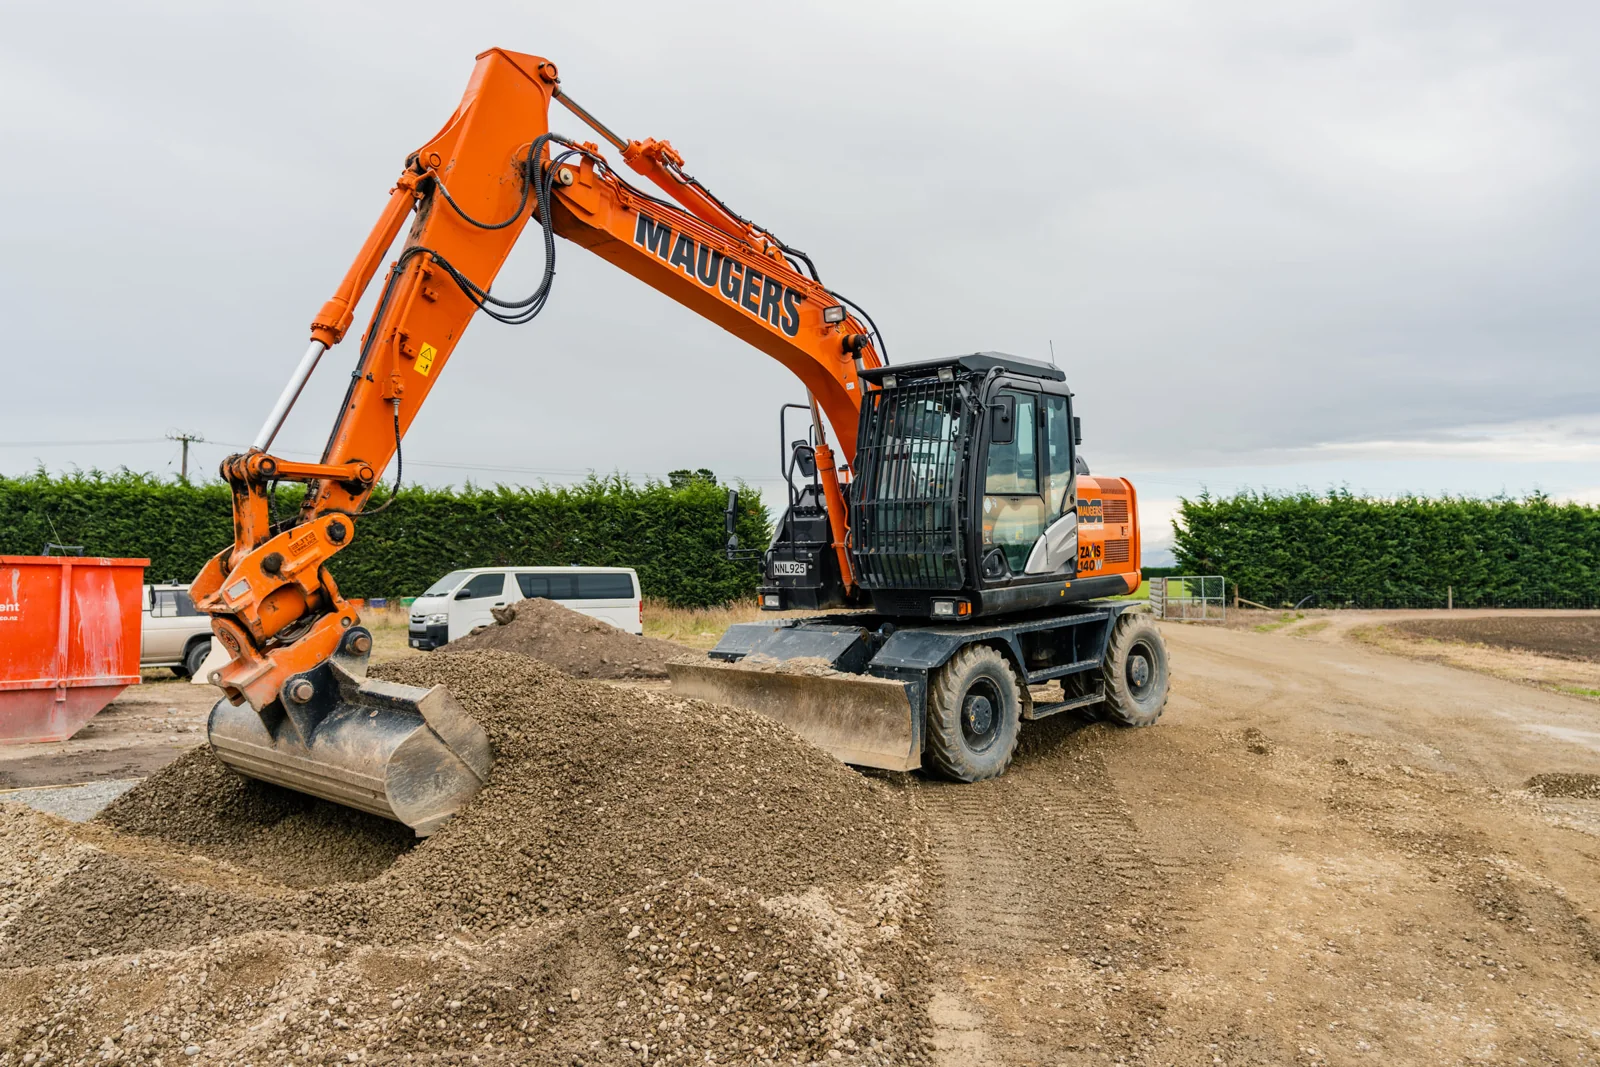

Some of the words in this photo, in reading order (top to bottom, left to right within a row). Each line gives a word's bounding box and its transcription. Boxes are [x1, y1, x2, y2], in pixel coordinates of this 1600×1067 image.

[633, 211, 801, 338] MAUGERS
[1078, 505, 1102, 516] MAUGERS
[774, 563, 804, 574] NNL925
